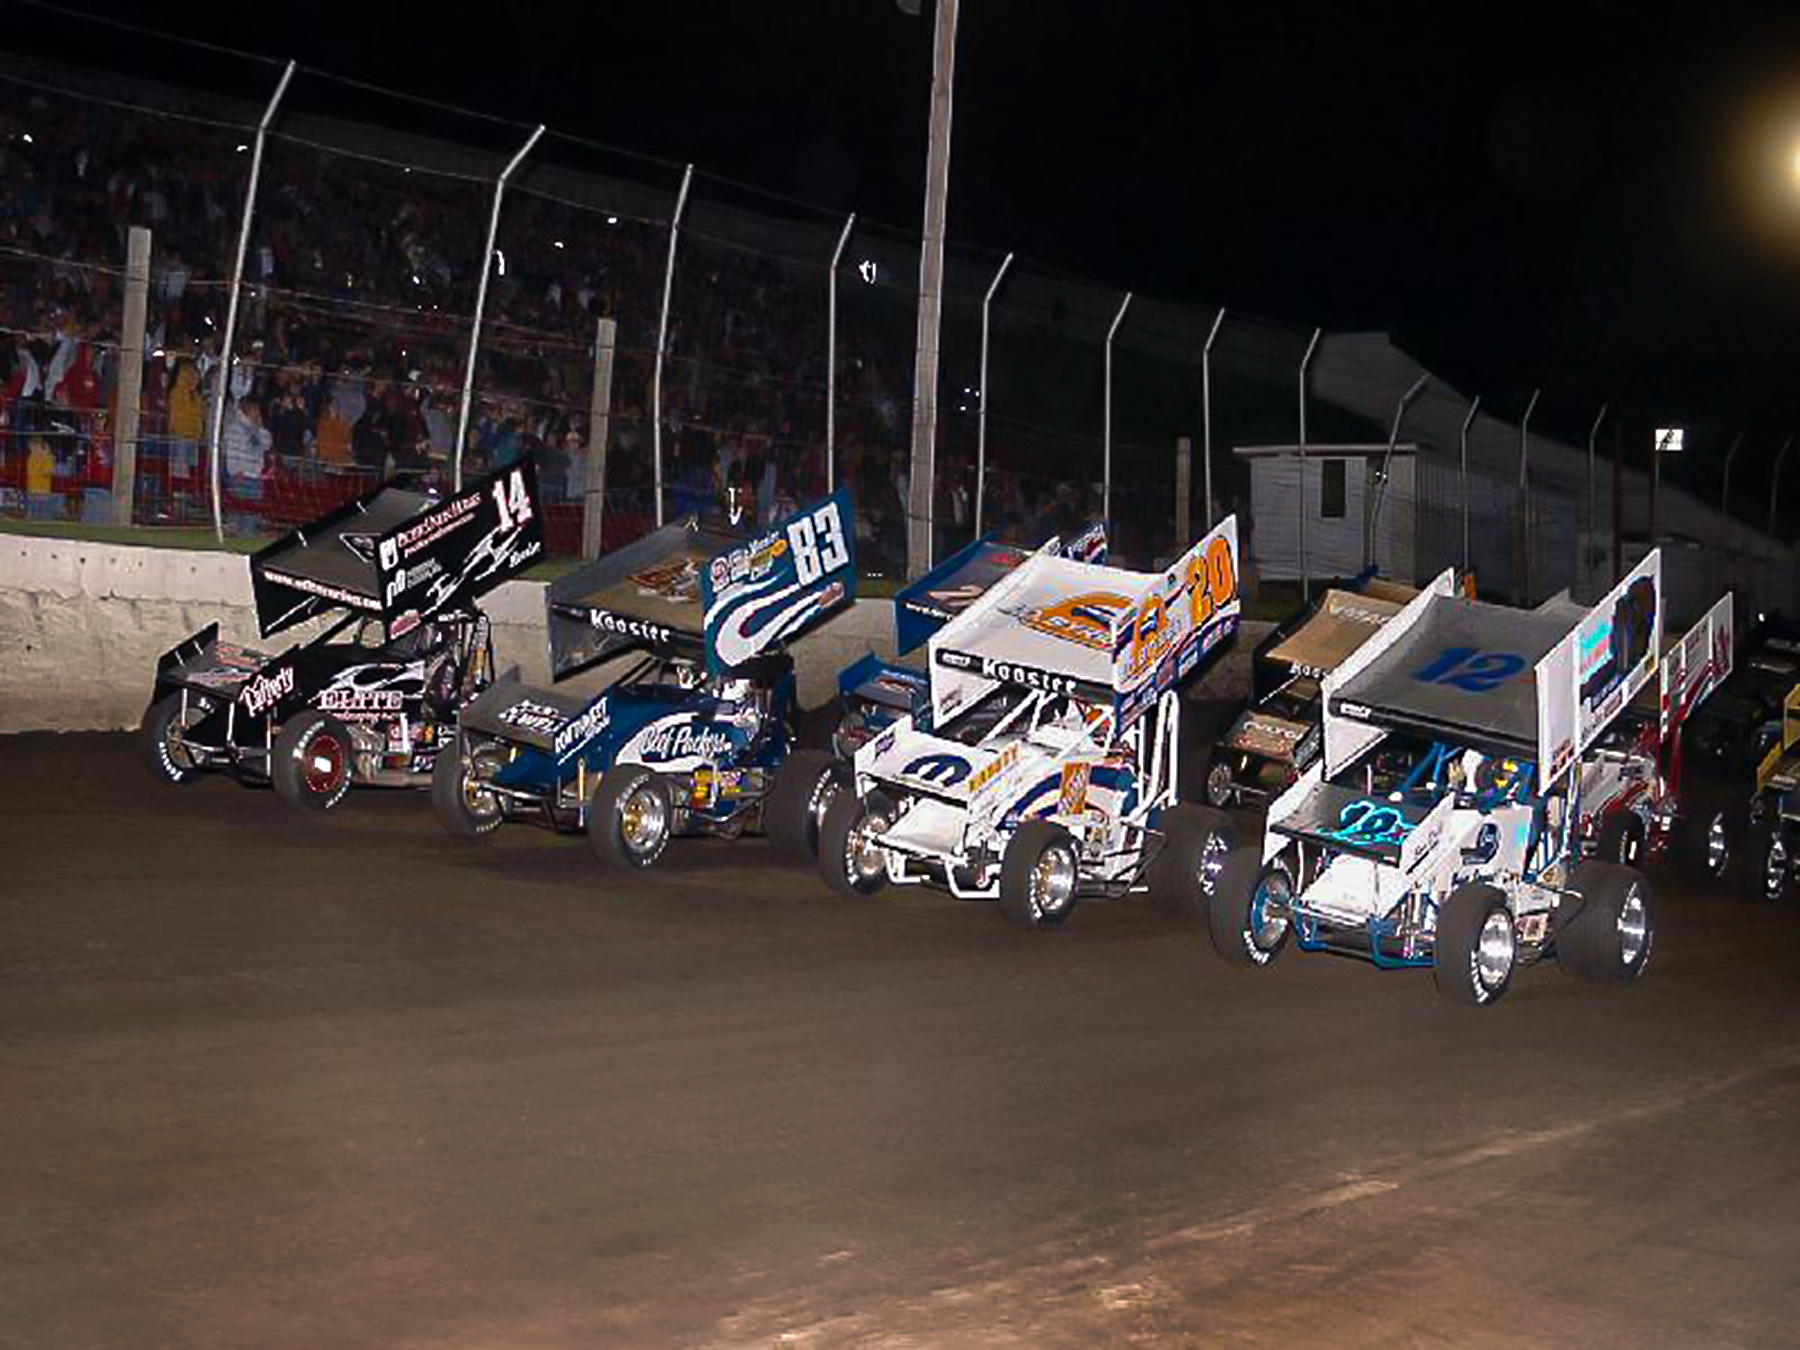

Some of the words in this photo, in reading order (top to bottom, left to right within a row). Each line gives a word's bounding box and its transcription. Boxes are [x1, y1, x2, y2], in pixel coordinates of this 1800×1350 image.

[492, 469, 533, 532] 14
[786, 501, 849, 586] 83
[1186, 534, 1237, 625] 20
[1408, 647, 1527, 693] 12
